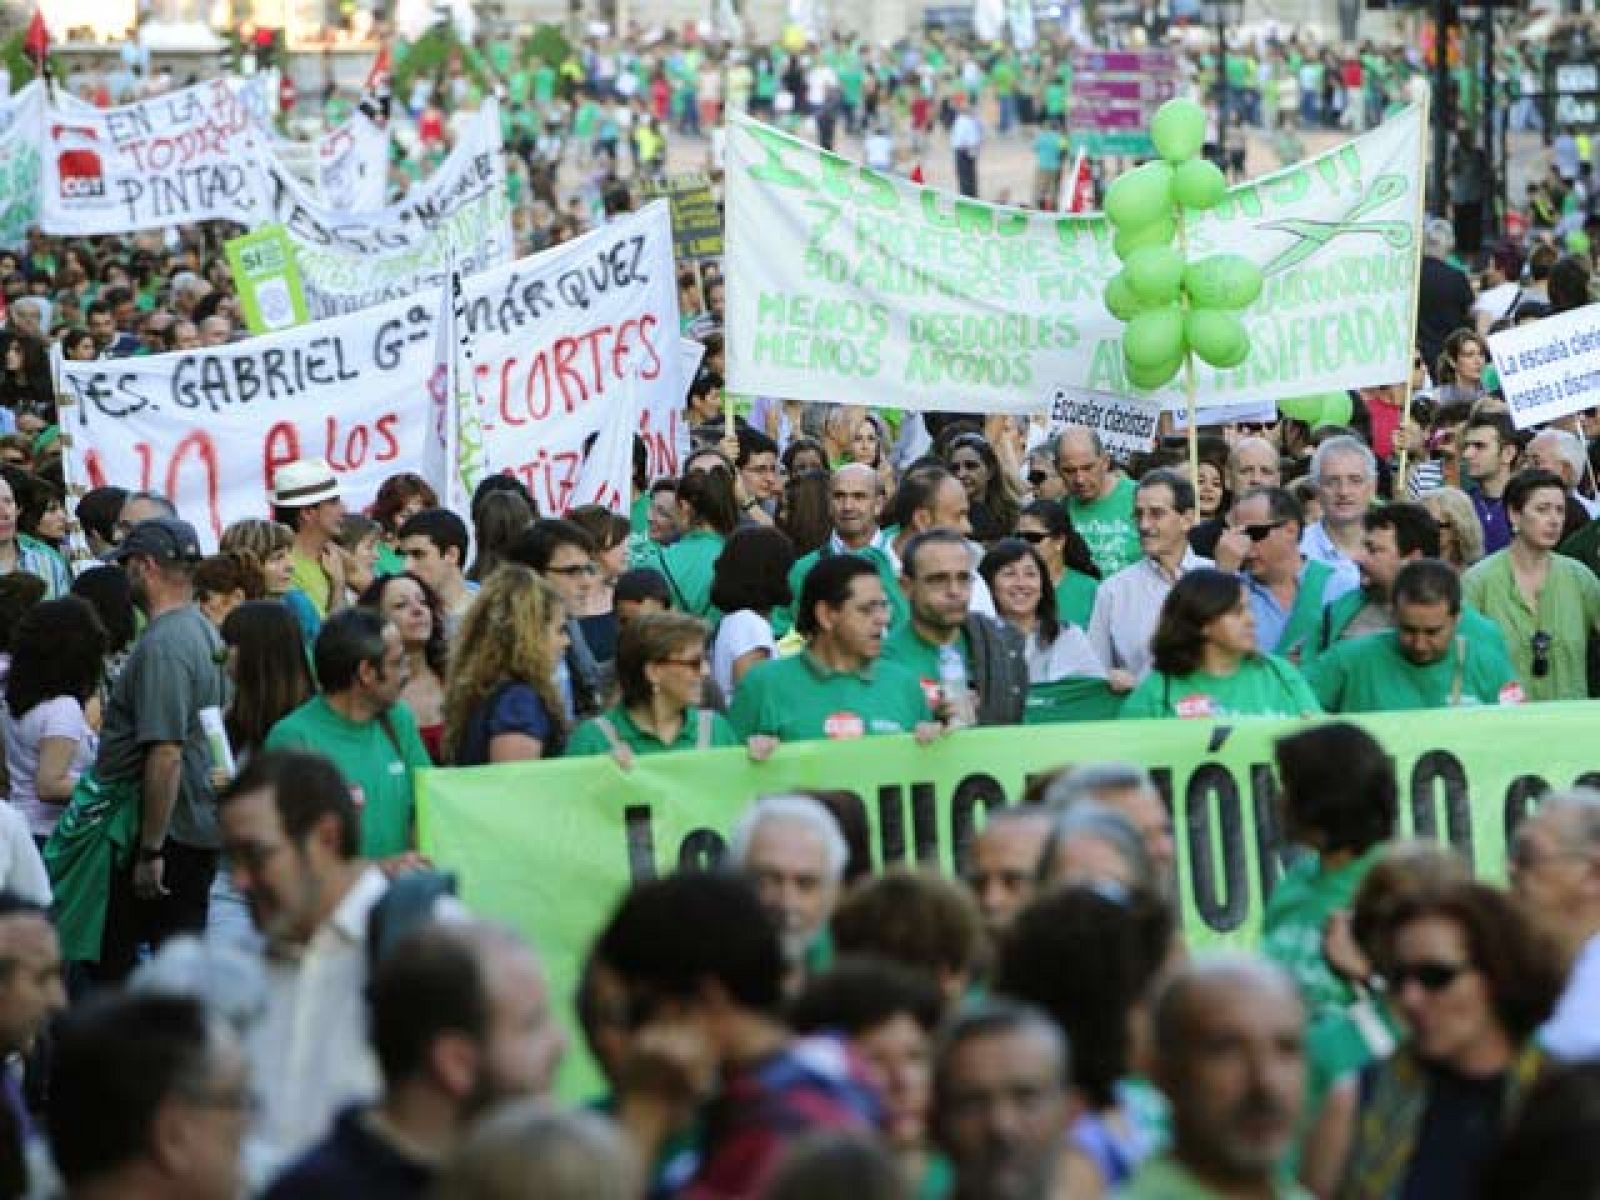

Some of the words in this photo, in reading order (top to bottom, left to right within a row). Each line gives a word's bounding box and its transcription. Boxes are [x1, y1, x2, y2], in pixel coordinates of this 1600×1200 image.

[758, 290, 889, 340] MENOS
[172, 336, 359, 412] GABRIEL
[754, 330, 881, 377] MENOS
[1051, 391, 1101, 428] Escuelas
